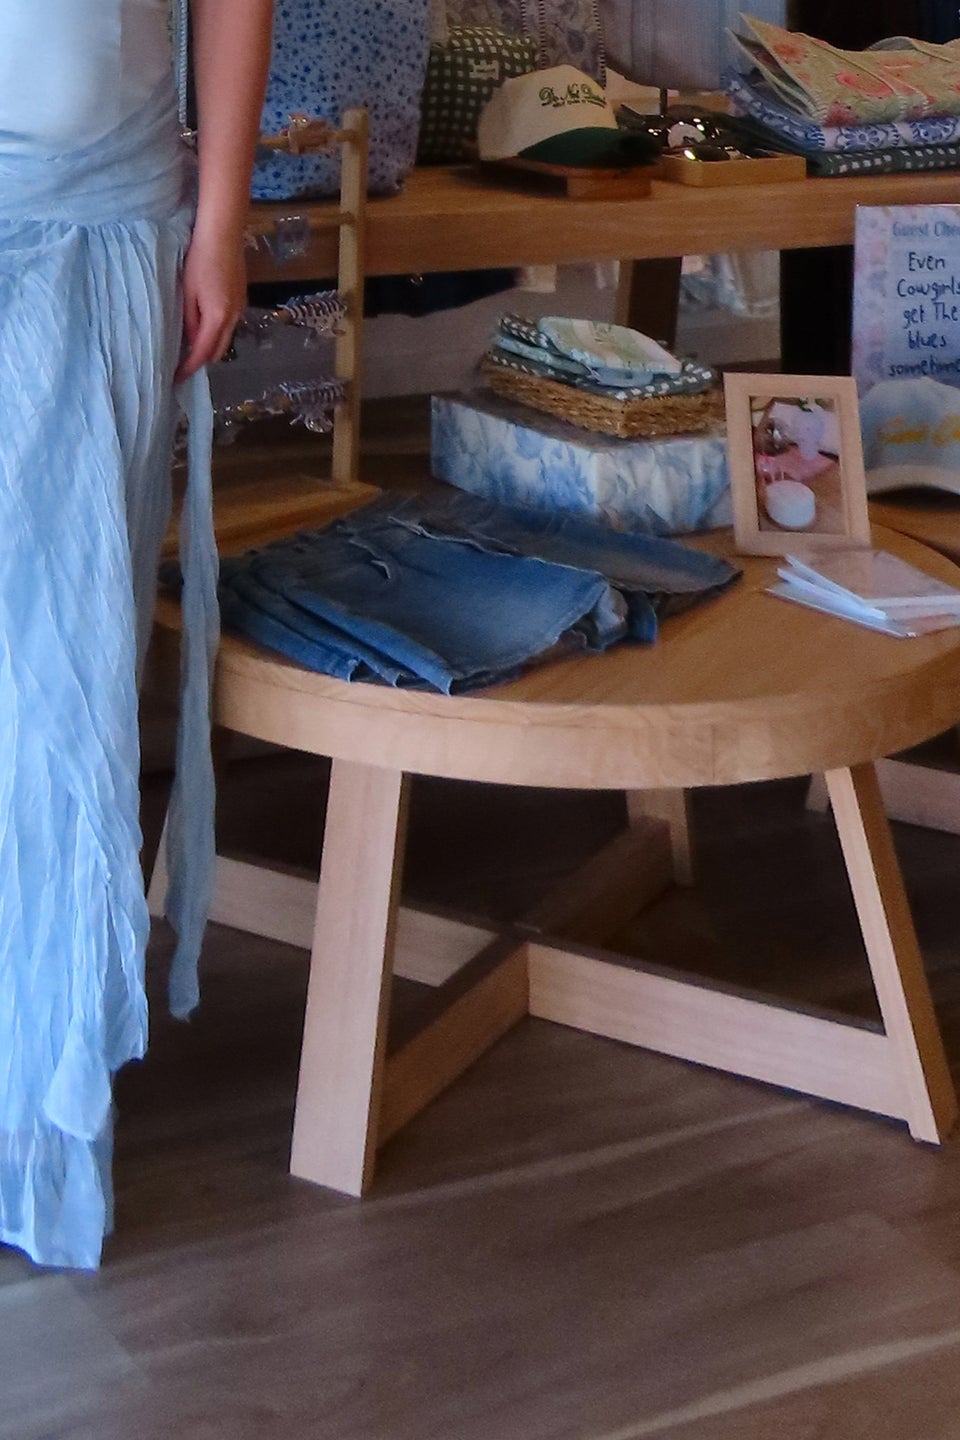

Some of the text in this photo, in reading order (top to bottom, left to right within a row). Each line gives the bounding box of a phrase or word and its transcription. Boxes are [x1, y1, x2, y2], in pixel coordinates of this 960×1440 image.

[908, 251, 945, 271] Even
[903, 302, 959, 329] get The
[908, 330, 947, 349] blues
